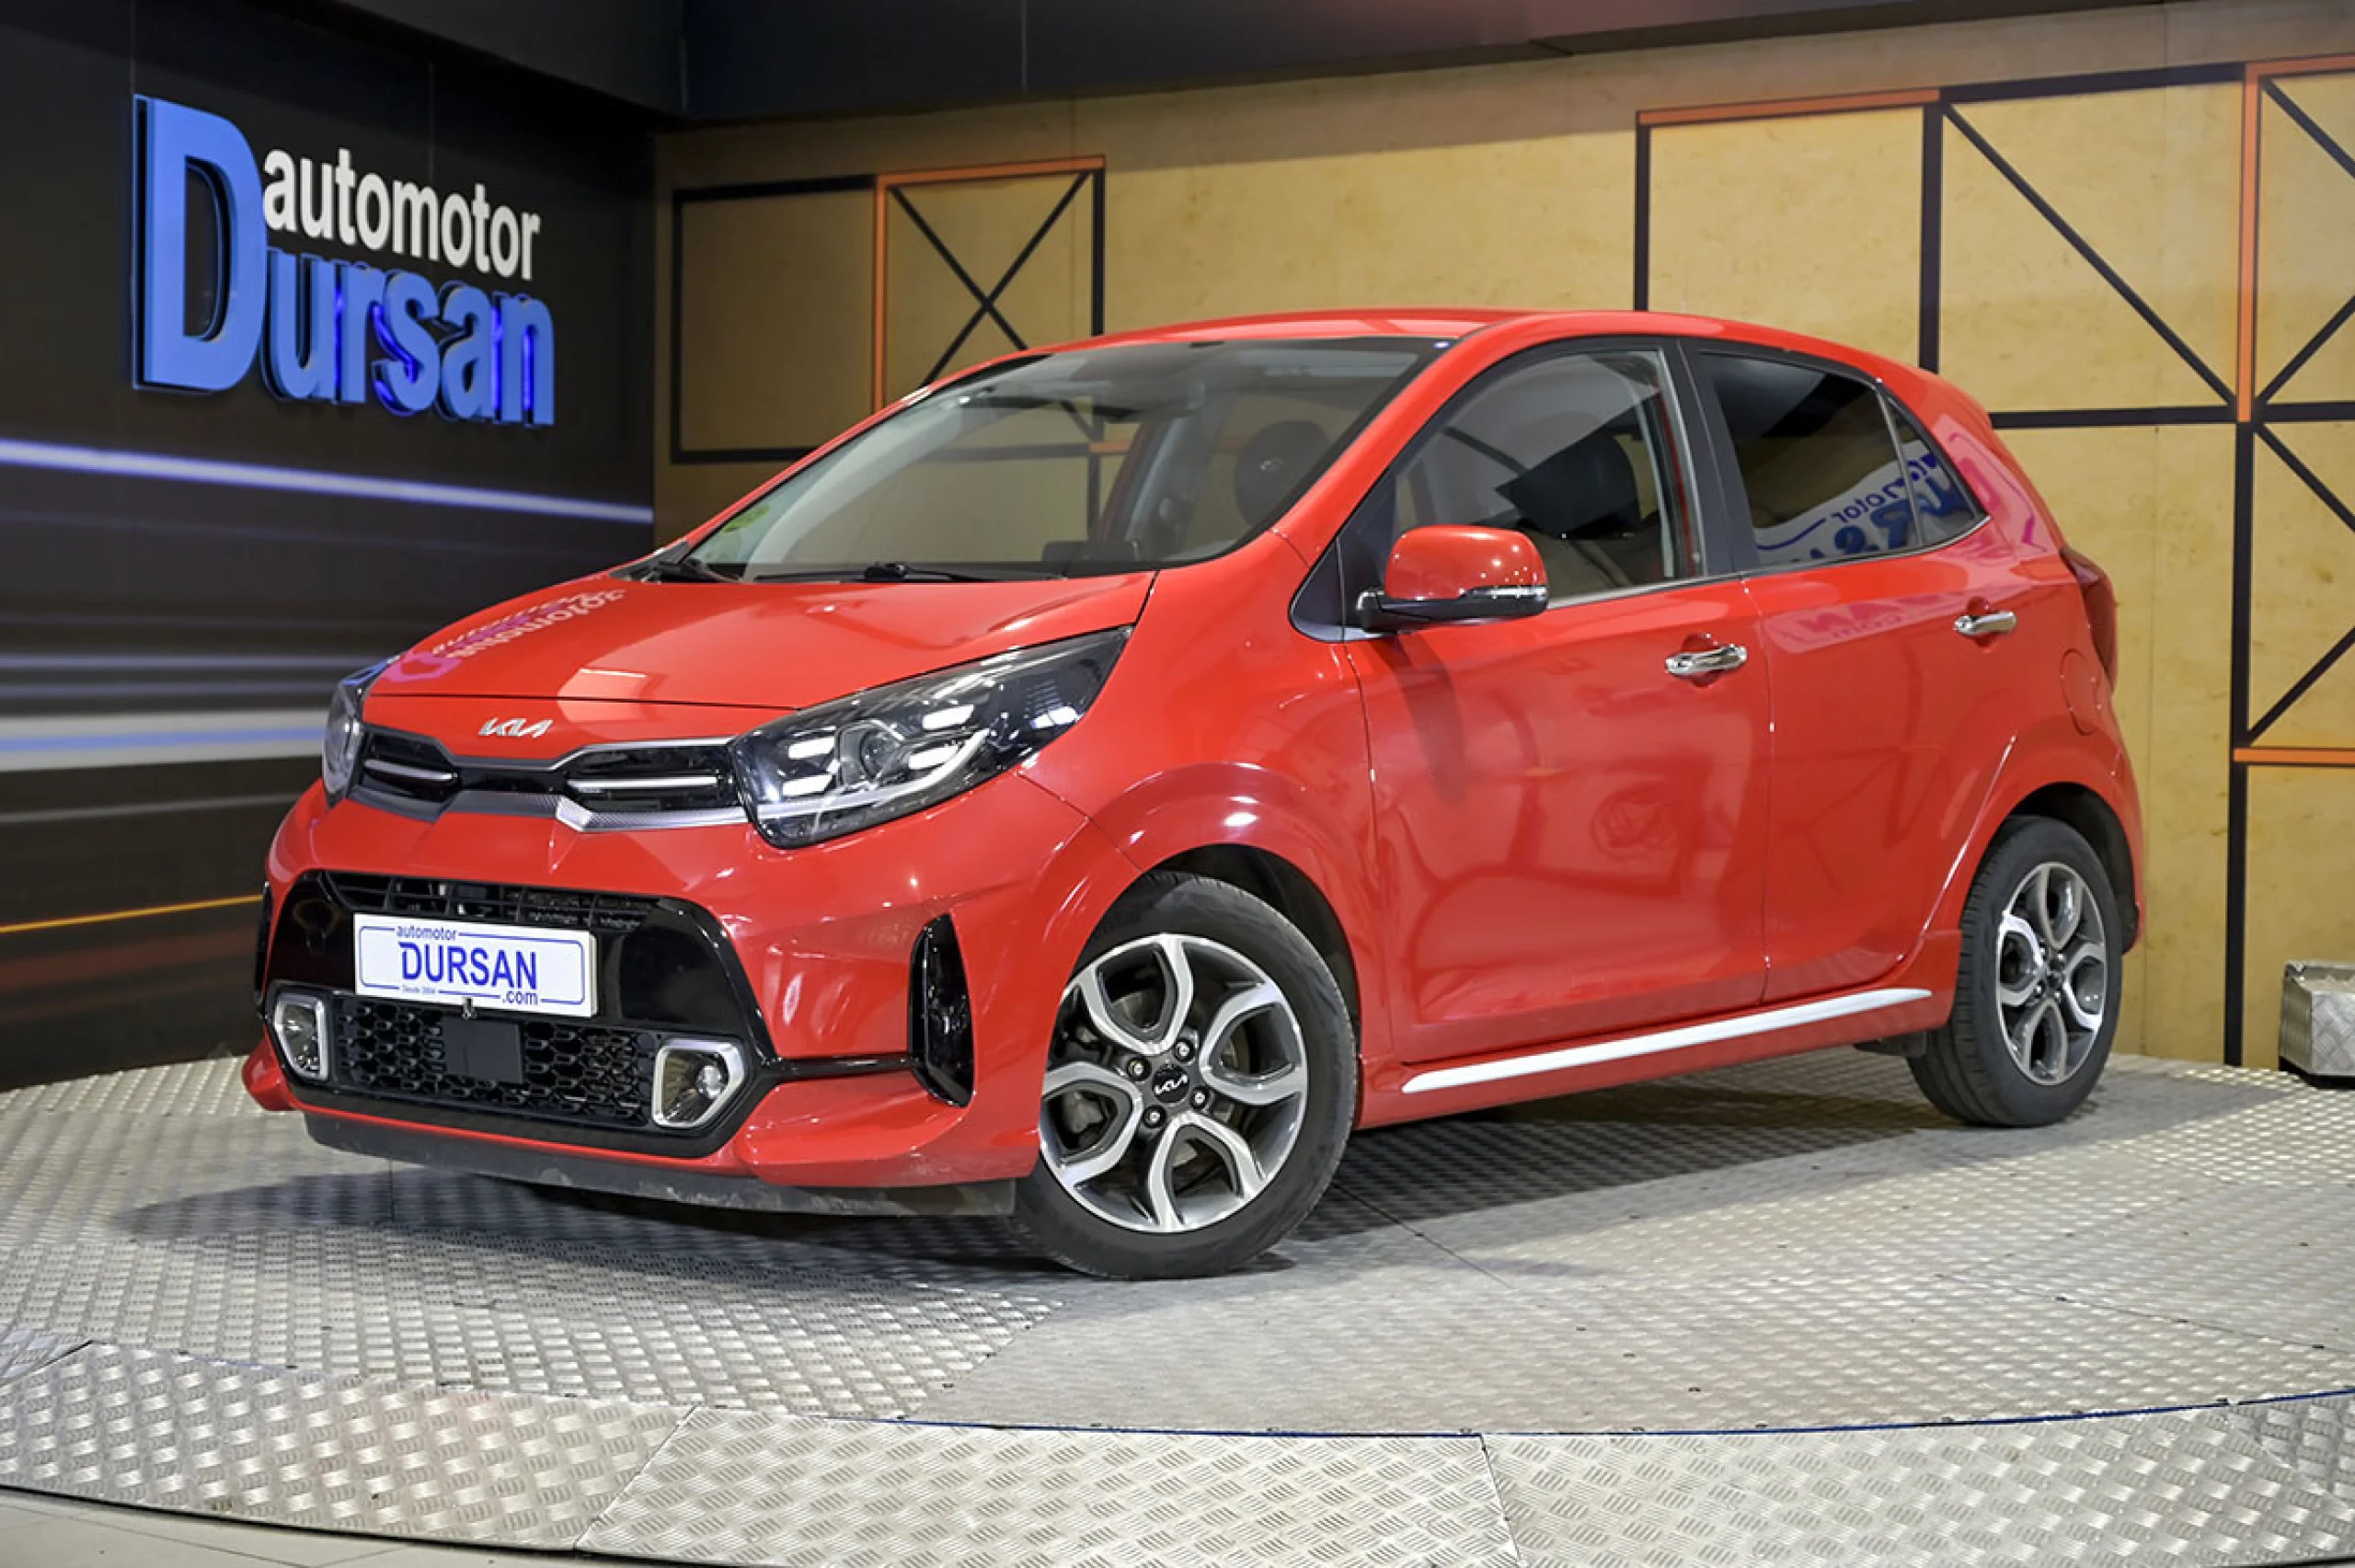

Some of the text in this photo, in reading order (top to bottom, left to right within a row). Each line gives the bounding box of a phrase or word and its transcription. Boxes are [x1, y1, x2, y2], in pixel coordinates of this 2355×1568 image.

[262, 147, 542, 281] automotor
[132, 93, 556, 427] Dursan
[477, 716, 554, 738] KIA
[396, 925, 457, 941] automotor
[398, 941, 537, 990] DURSAN
[502, 990, 538, 1005] .com
